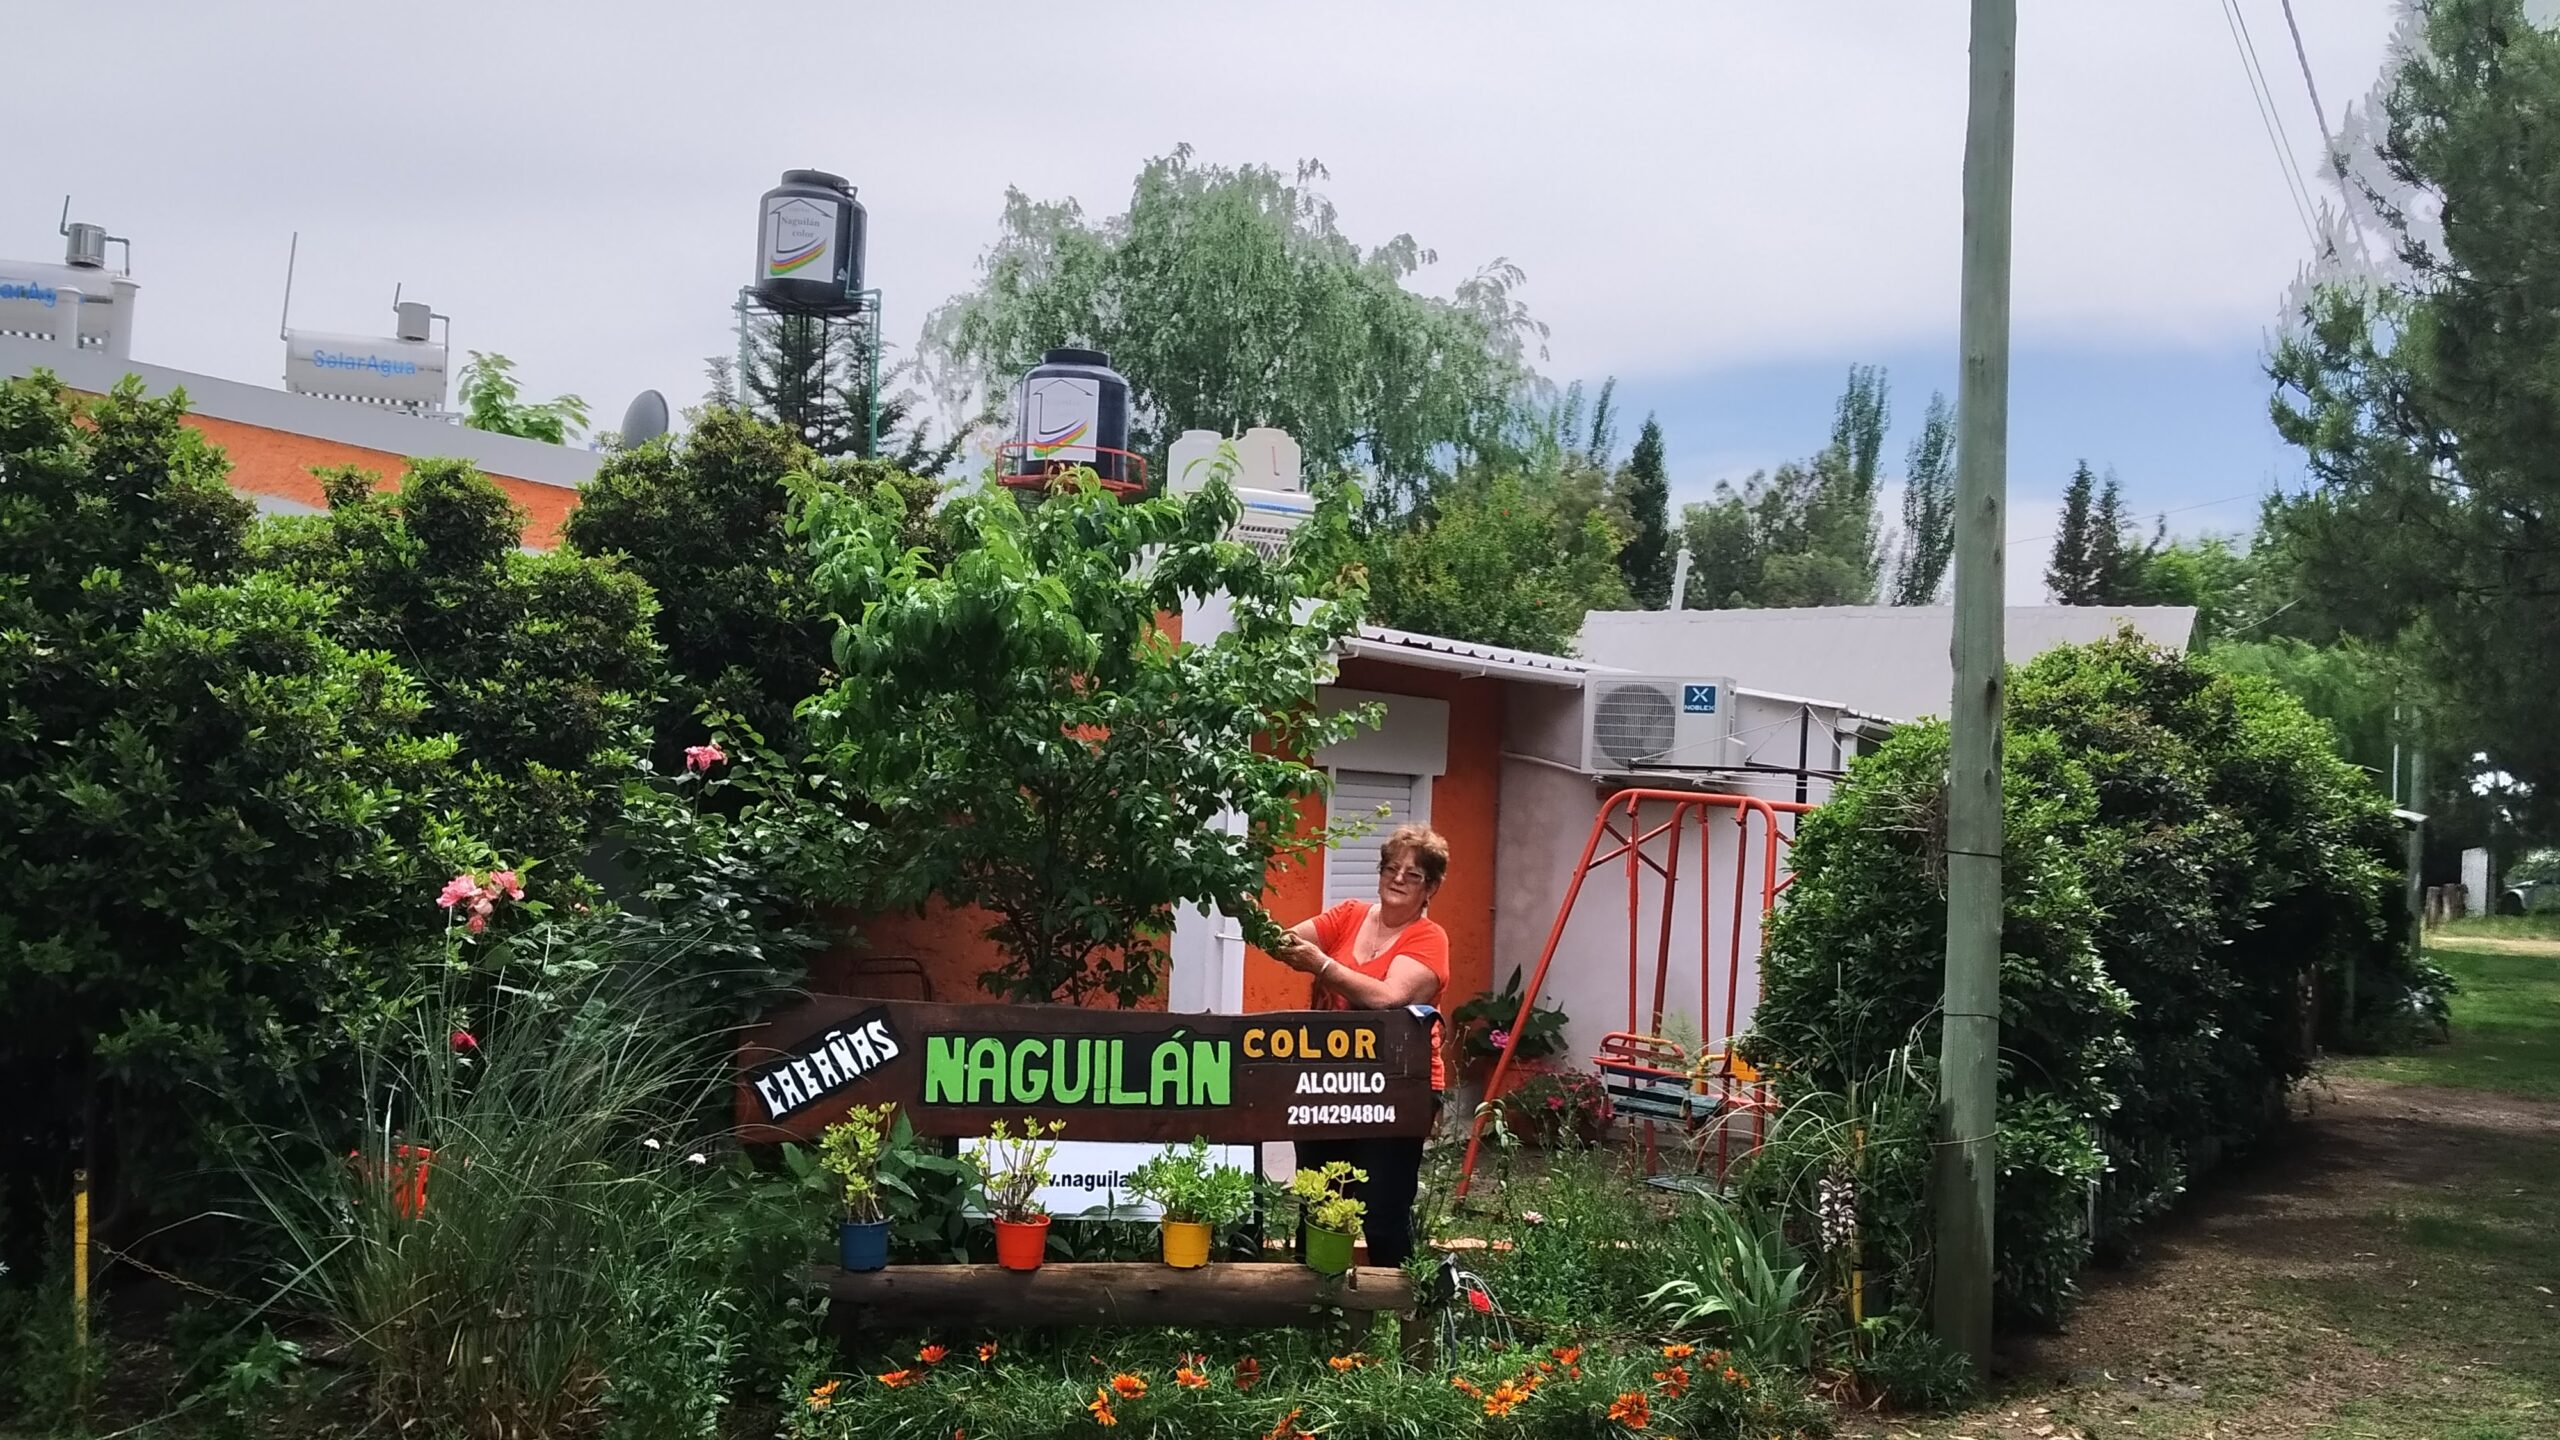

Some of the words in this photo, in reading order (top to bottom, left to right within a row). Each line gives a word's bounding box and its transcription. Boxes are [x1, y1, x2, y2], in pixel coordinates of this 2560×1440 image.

[312, 349, 417, 378] SolarAgua
[755, 1019, 899, 1120] CABAÑAS
[925, 1030, 1231, 1105] NAGUILÁN
[1243, 1025, 1377, 1059] COLOR
[1295, 1071, 1386, 1094] ALQUILO
[1287, 1104, 1396, 1125] 2914294804
